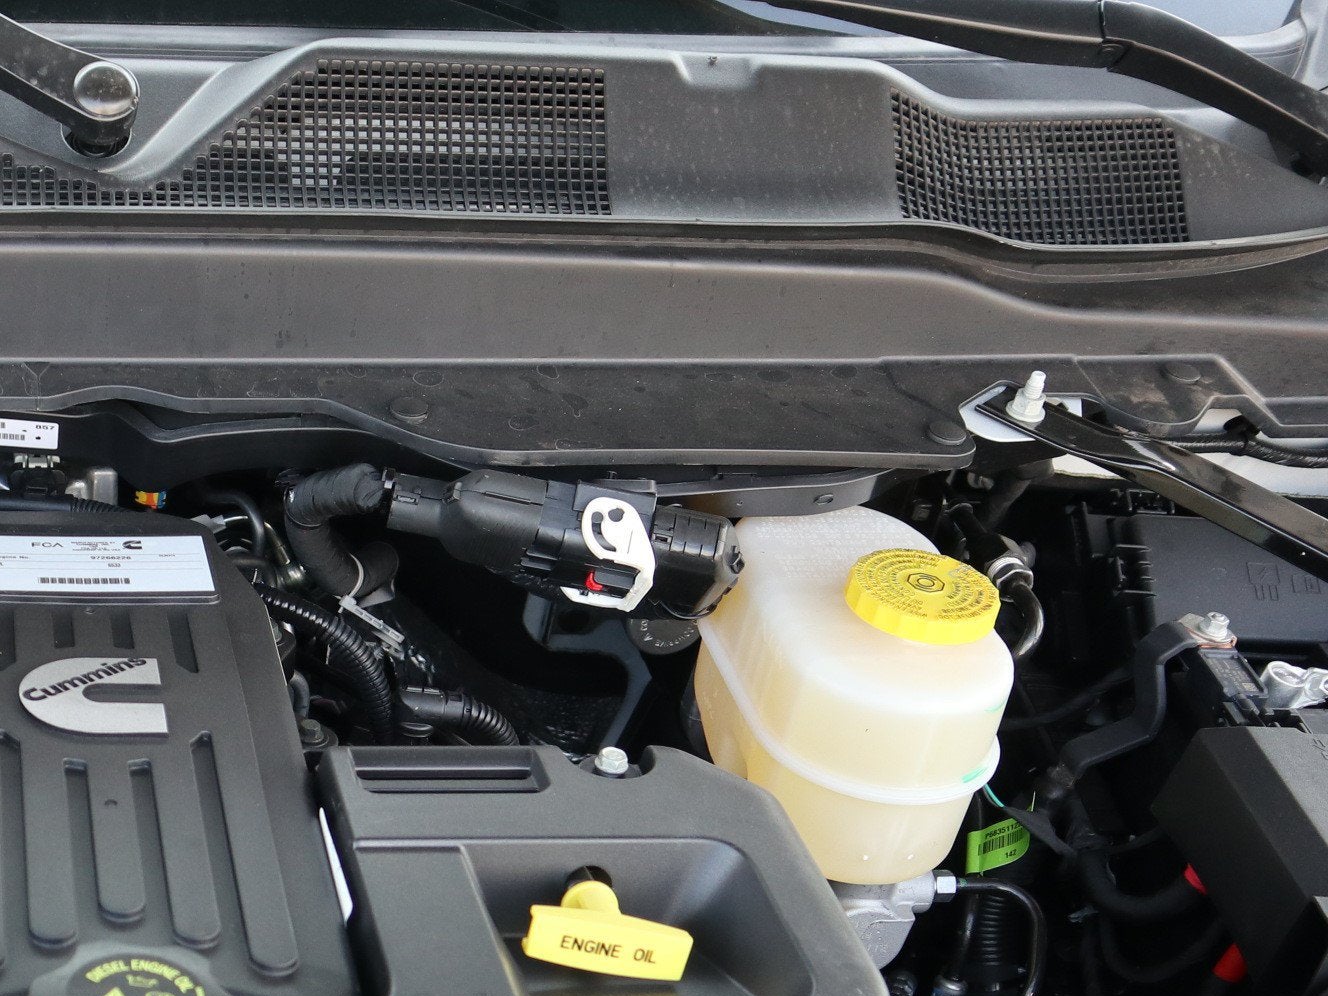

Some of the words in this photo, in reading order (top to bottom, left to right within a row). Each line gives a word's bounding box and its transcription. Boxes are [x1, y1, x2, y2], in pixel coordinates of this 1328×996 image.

[22, 657, 147, 701] Cummins
[560, 934, 623, 959] ENGINE
[633, 948, 657, 964] OIL
